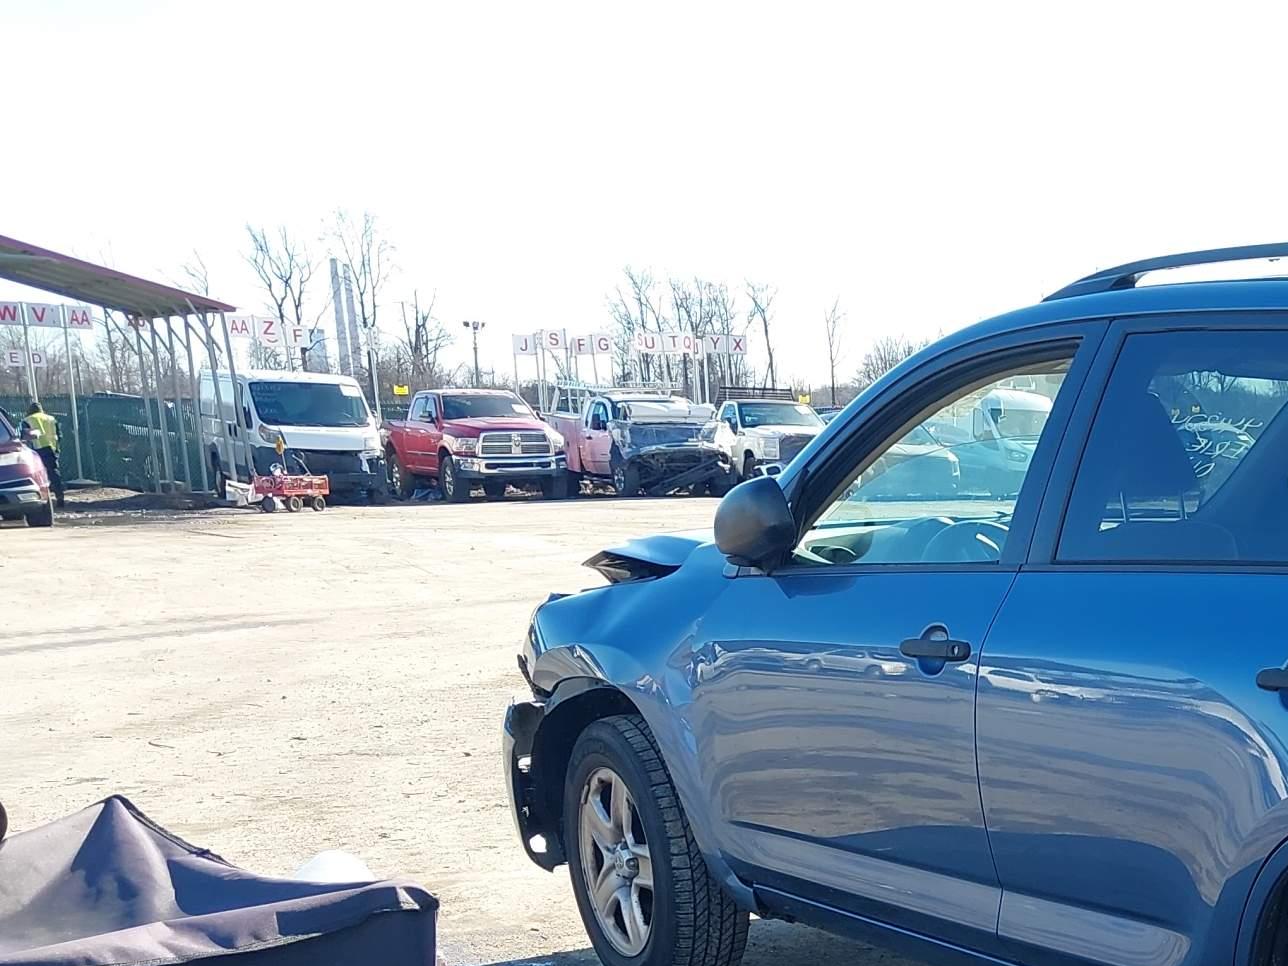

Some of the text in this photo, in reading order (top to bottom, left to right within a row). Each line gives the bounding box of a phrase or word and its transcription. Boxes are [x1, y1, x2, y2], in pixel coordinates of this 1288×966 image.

[0, 305, 17, 320] W
[28, 307, 46, 323] V
[69, 309, 90, 326] AA
[230, 322, 250, 336] AA
[263, 320, 275, 336] Z
[292, 328, 303, 343] F
[549, 332, 560, 347] S
[669, 335, 679, 349] T
[683, 335, 693, 350] Q
[519, 338, 529, 351] J
[577, 338, 586, 351] F
[597, 338, 609, 351] G
[644, 336, 656, 350] U
[710, 336, 721, 350] Y
[733, 338, 744, 352] X
[9, 352, 19, 363] E
[30, 353, 42, 364] D
